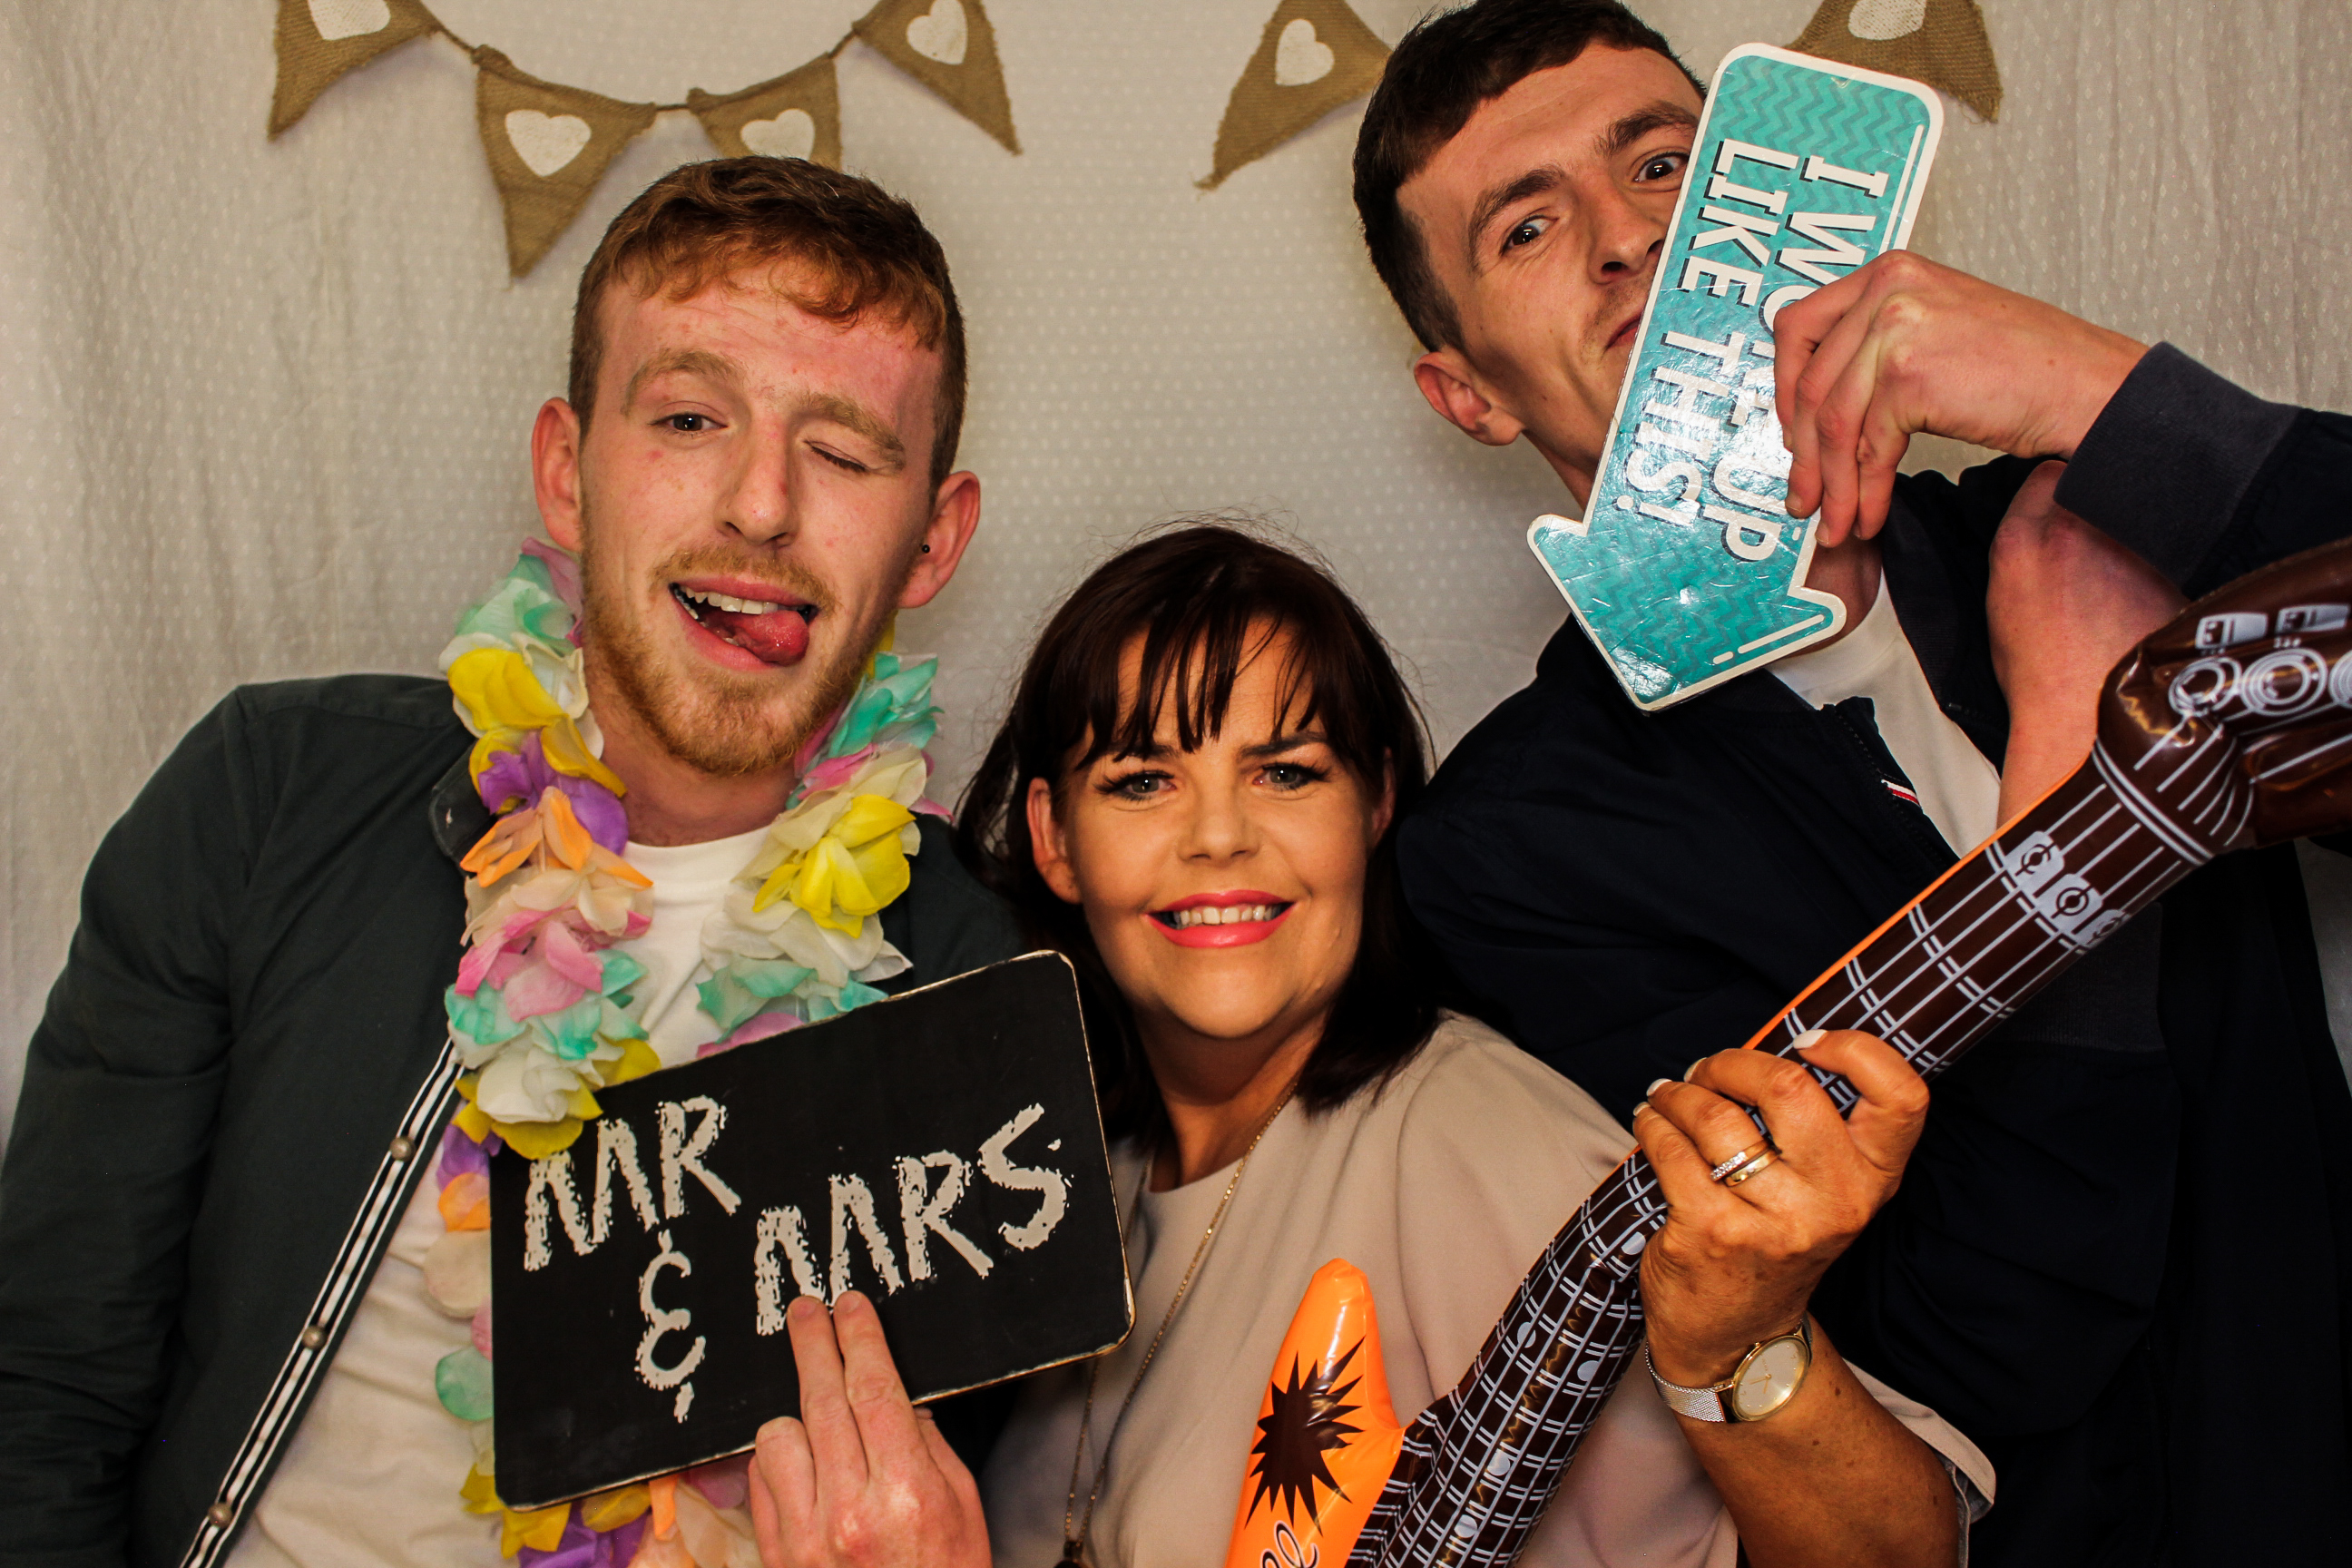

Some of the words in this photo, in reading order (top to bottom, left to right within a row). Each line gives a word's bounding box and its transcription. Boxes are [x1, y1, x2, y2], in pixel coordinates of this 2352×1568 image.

[1681, 138, 1800, 309] LIKE
[1802, 153, 1890, 199] I
[1729, 211, 1877, 429] WE
[1616, 329, 1748, 528] THIS!
[1702, 454, 1794, 562] UP
[524, 1095, 741, 1271] MR
[635, 1230, 706, 1423] &
